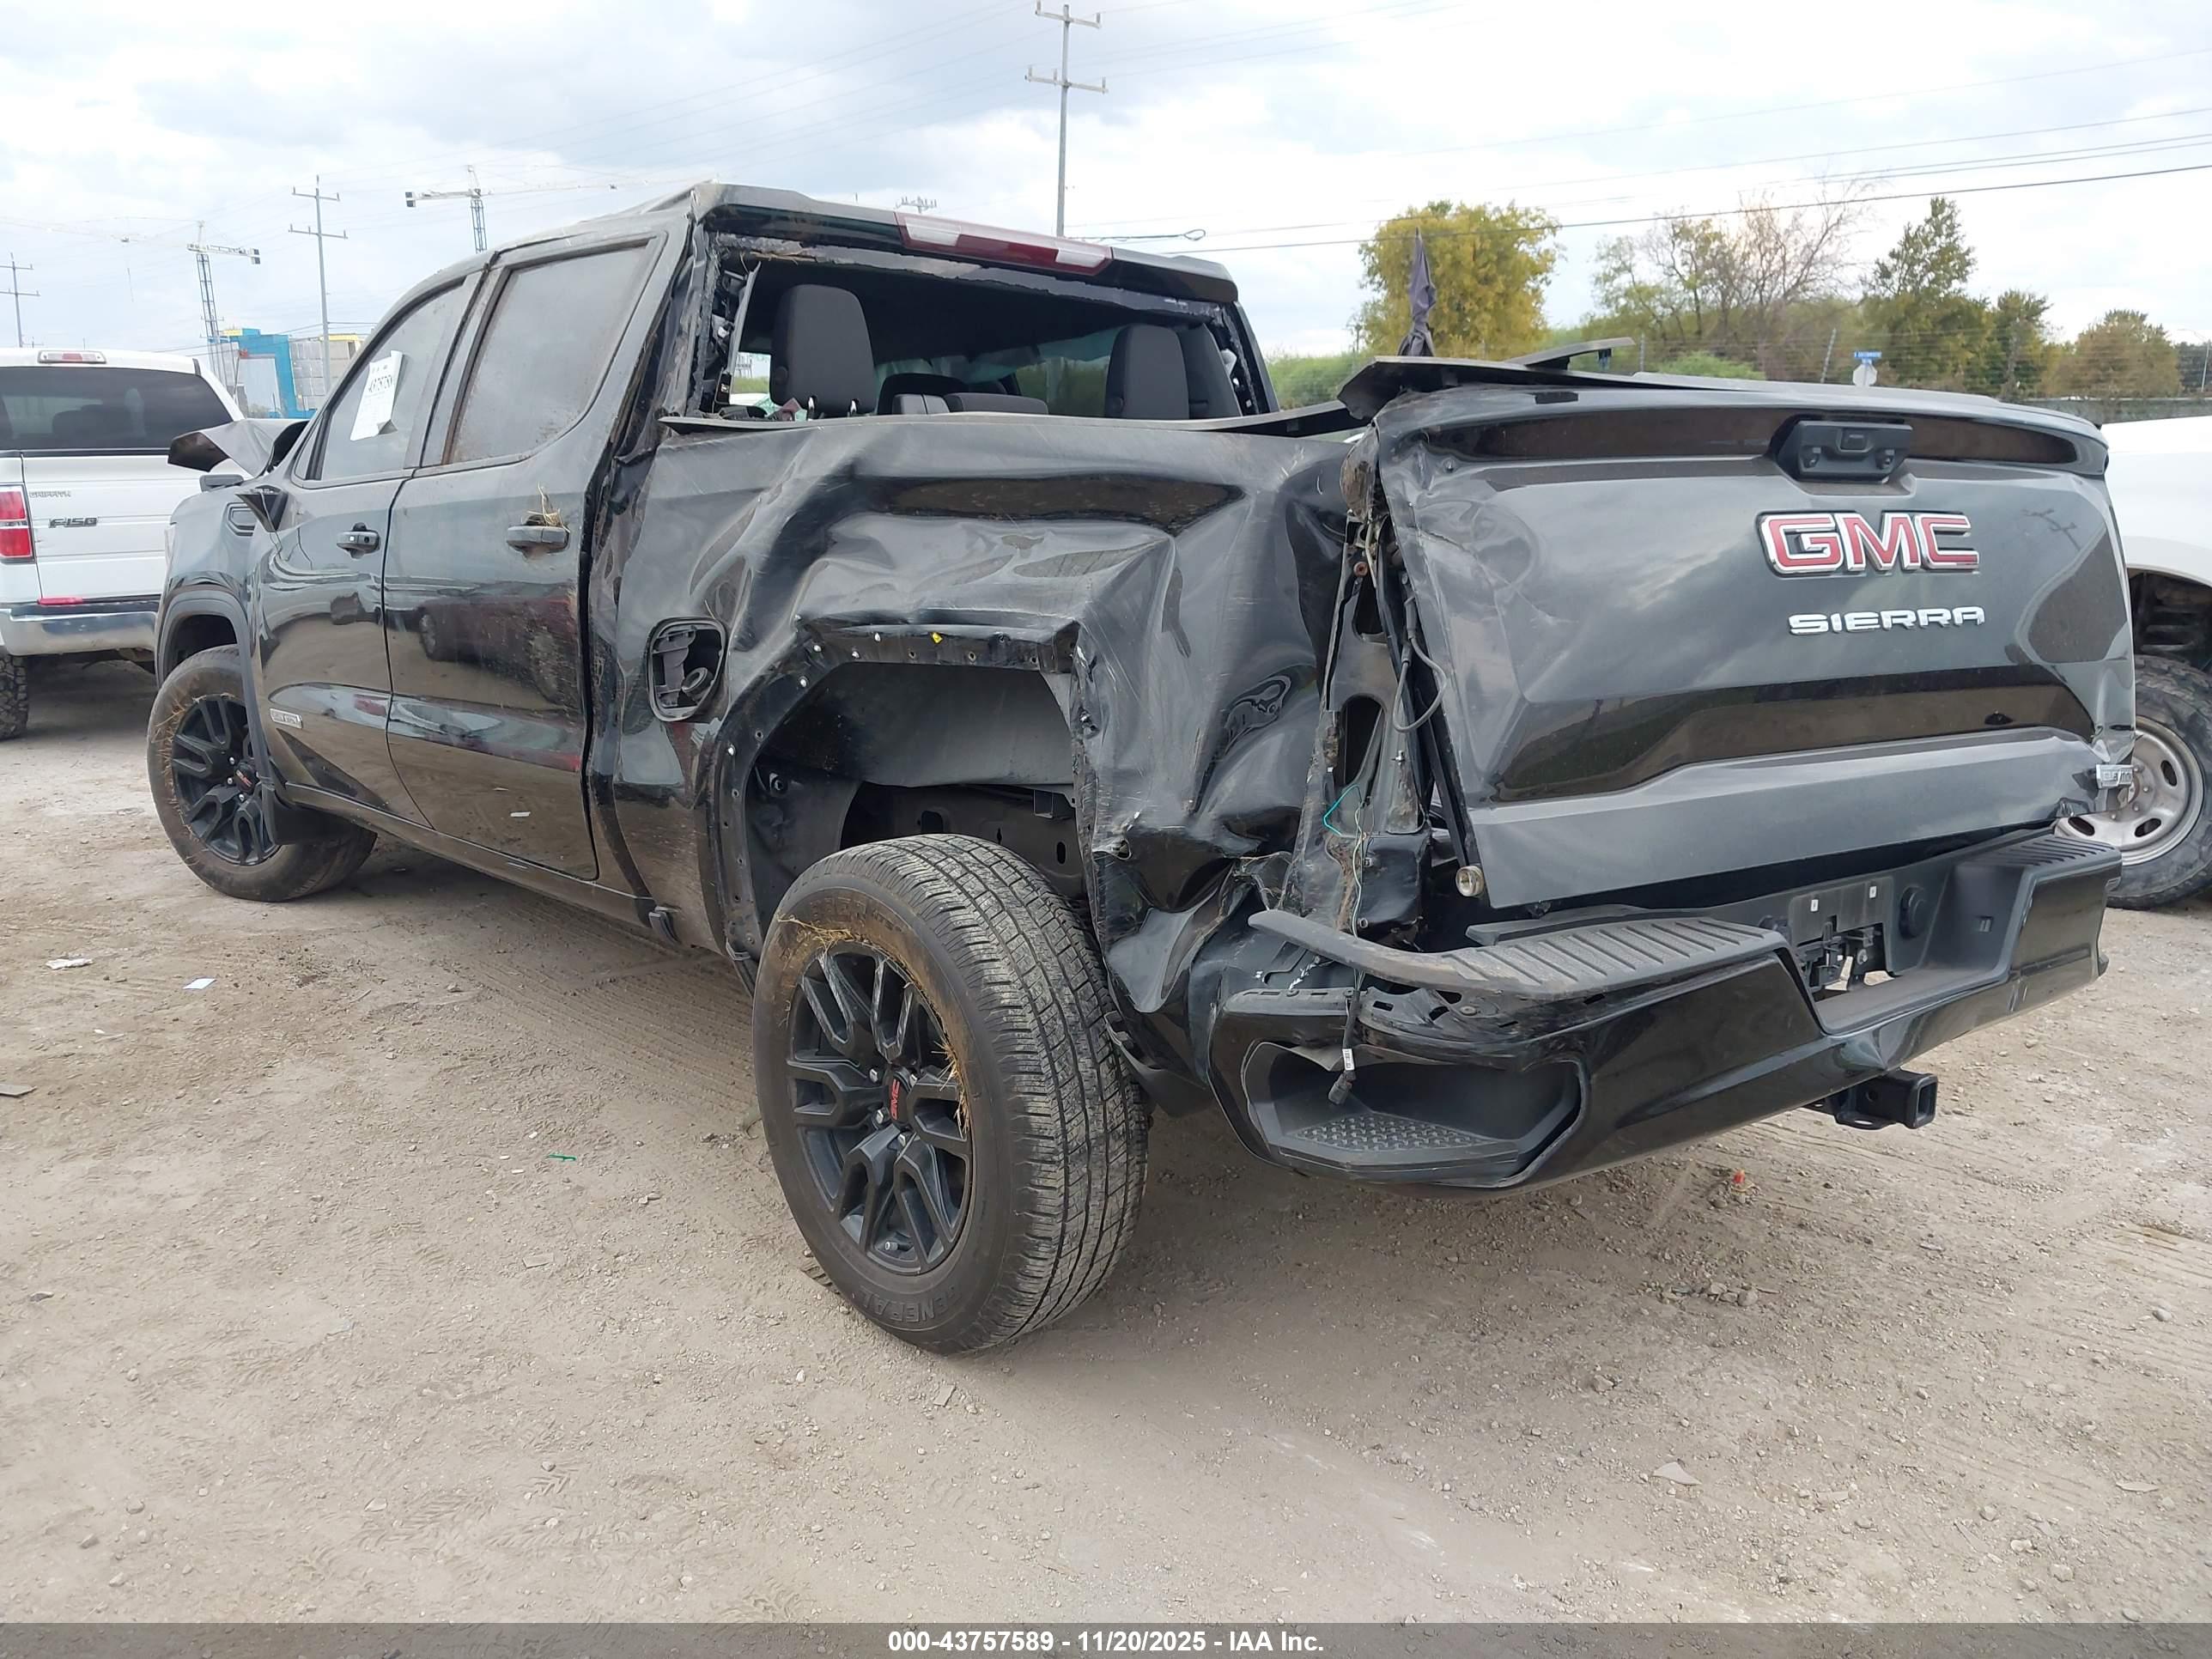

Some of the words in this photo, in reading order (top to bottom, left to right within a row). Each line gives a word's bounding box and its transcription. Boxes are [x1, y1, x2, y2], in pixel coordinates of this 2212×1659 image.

[49, 517, 97, 528] F-150
[1759, 512, 1980, 575] GMC
[1788, 605, 1986, 636] SIERRA
[890, 1078, 901, 1121] GMC
